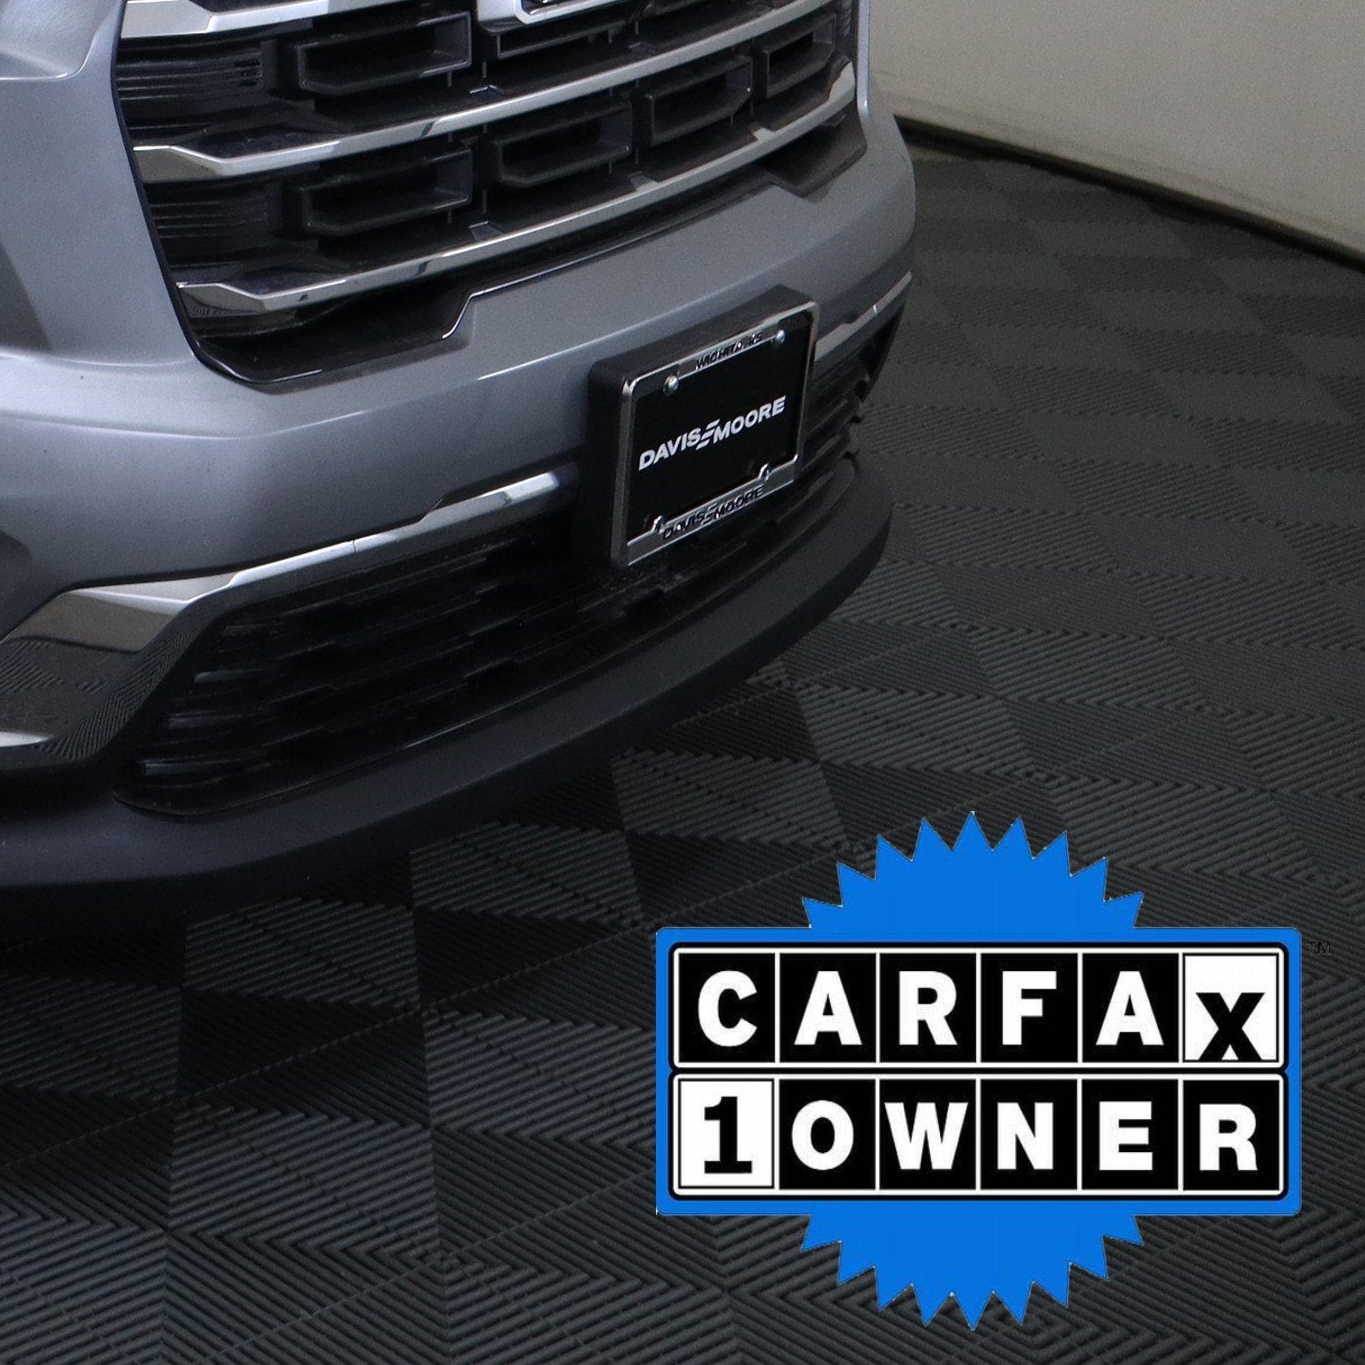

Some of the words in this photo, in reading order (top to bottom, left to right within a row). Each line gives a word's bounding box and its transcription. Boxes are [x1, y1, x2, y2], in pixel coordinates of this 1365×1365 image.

[638, 426, 701, 471] DAVIS
[713, 396, 786, 445] MOORE
[713, 483, 765, 519] MOORE
